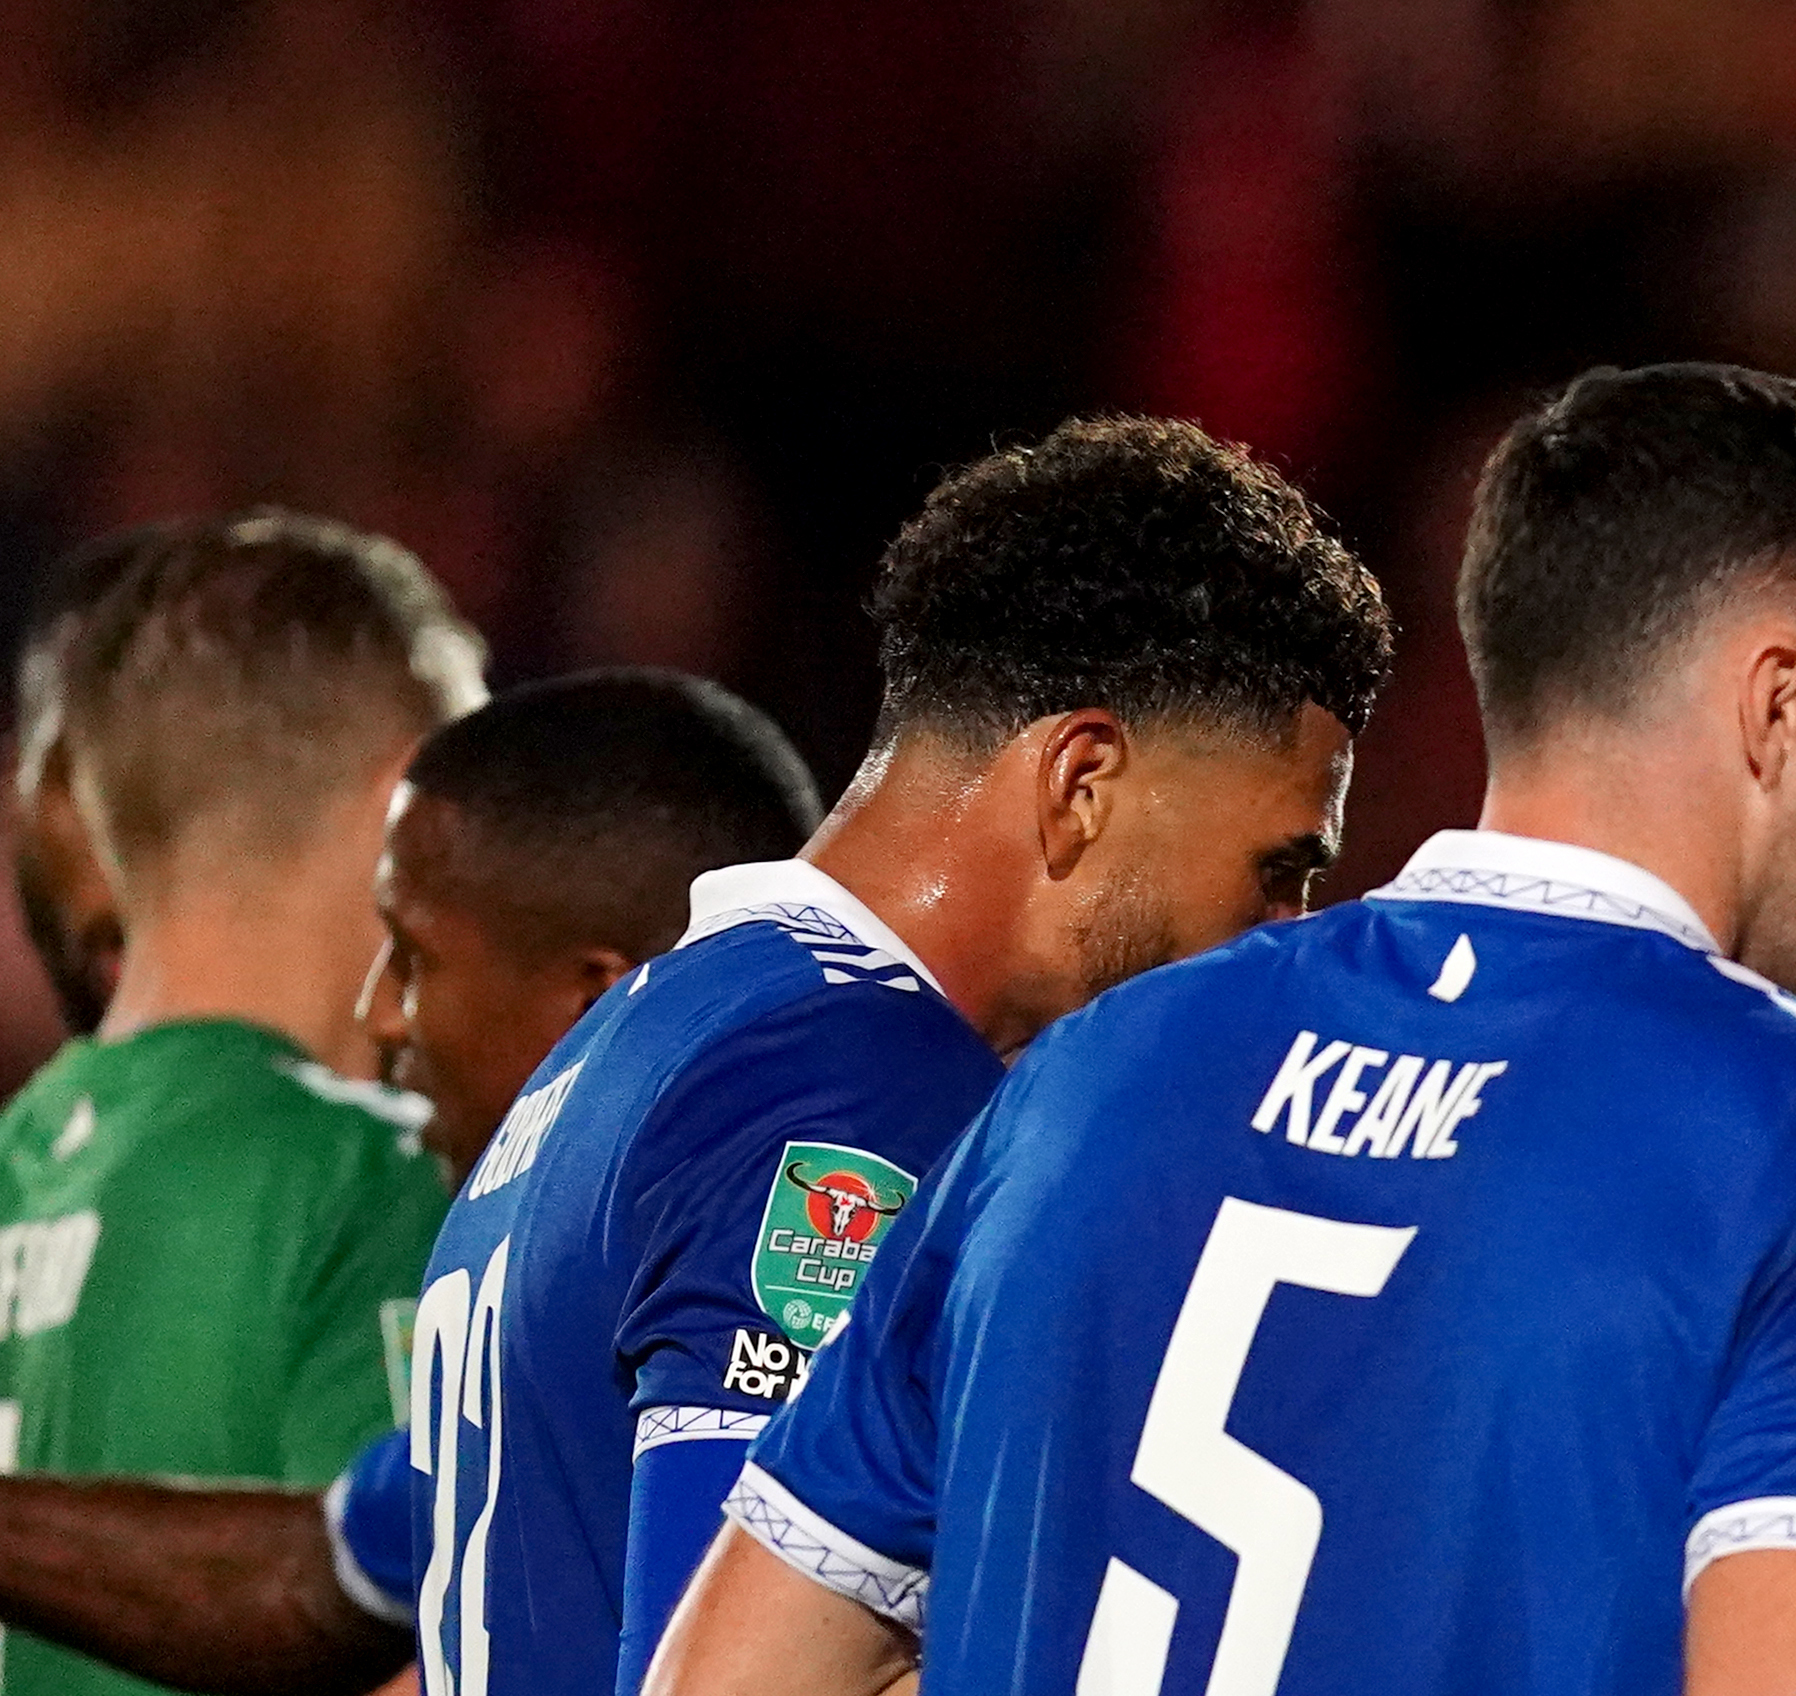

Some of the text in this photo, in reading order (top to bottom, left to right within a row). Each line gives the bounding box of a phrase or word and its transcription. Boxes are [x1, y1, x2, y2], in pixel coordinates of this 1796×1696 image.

[1250, 1030, 1508, 1159] KEANE
[768, 1228, 878, 1263] Caraba
[796, 1257, 857, 1291] Cup
[811, 1312, 838, 1334] EF
[731, 1328, 790, 1371] No
[723, 1360, 785, 1398] for
